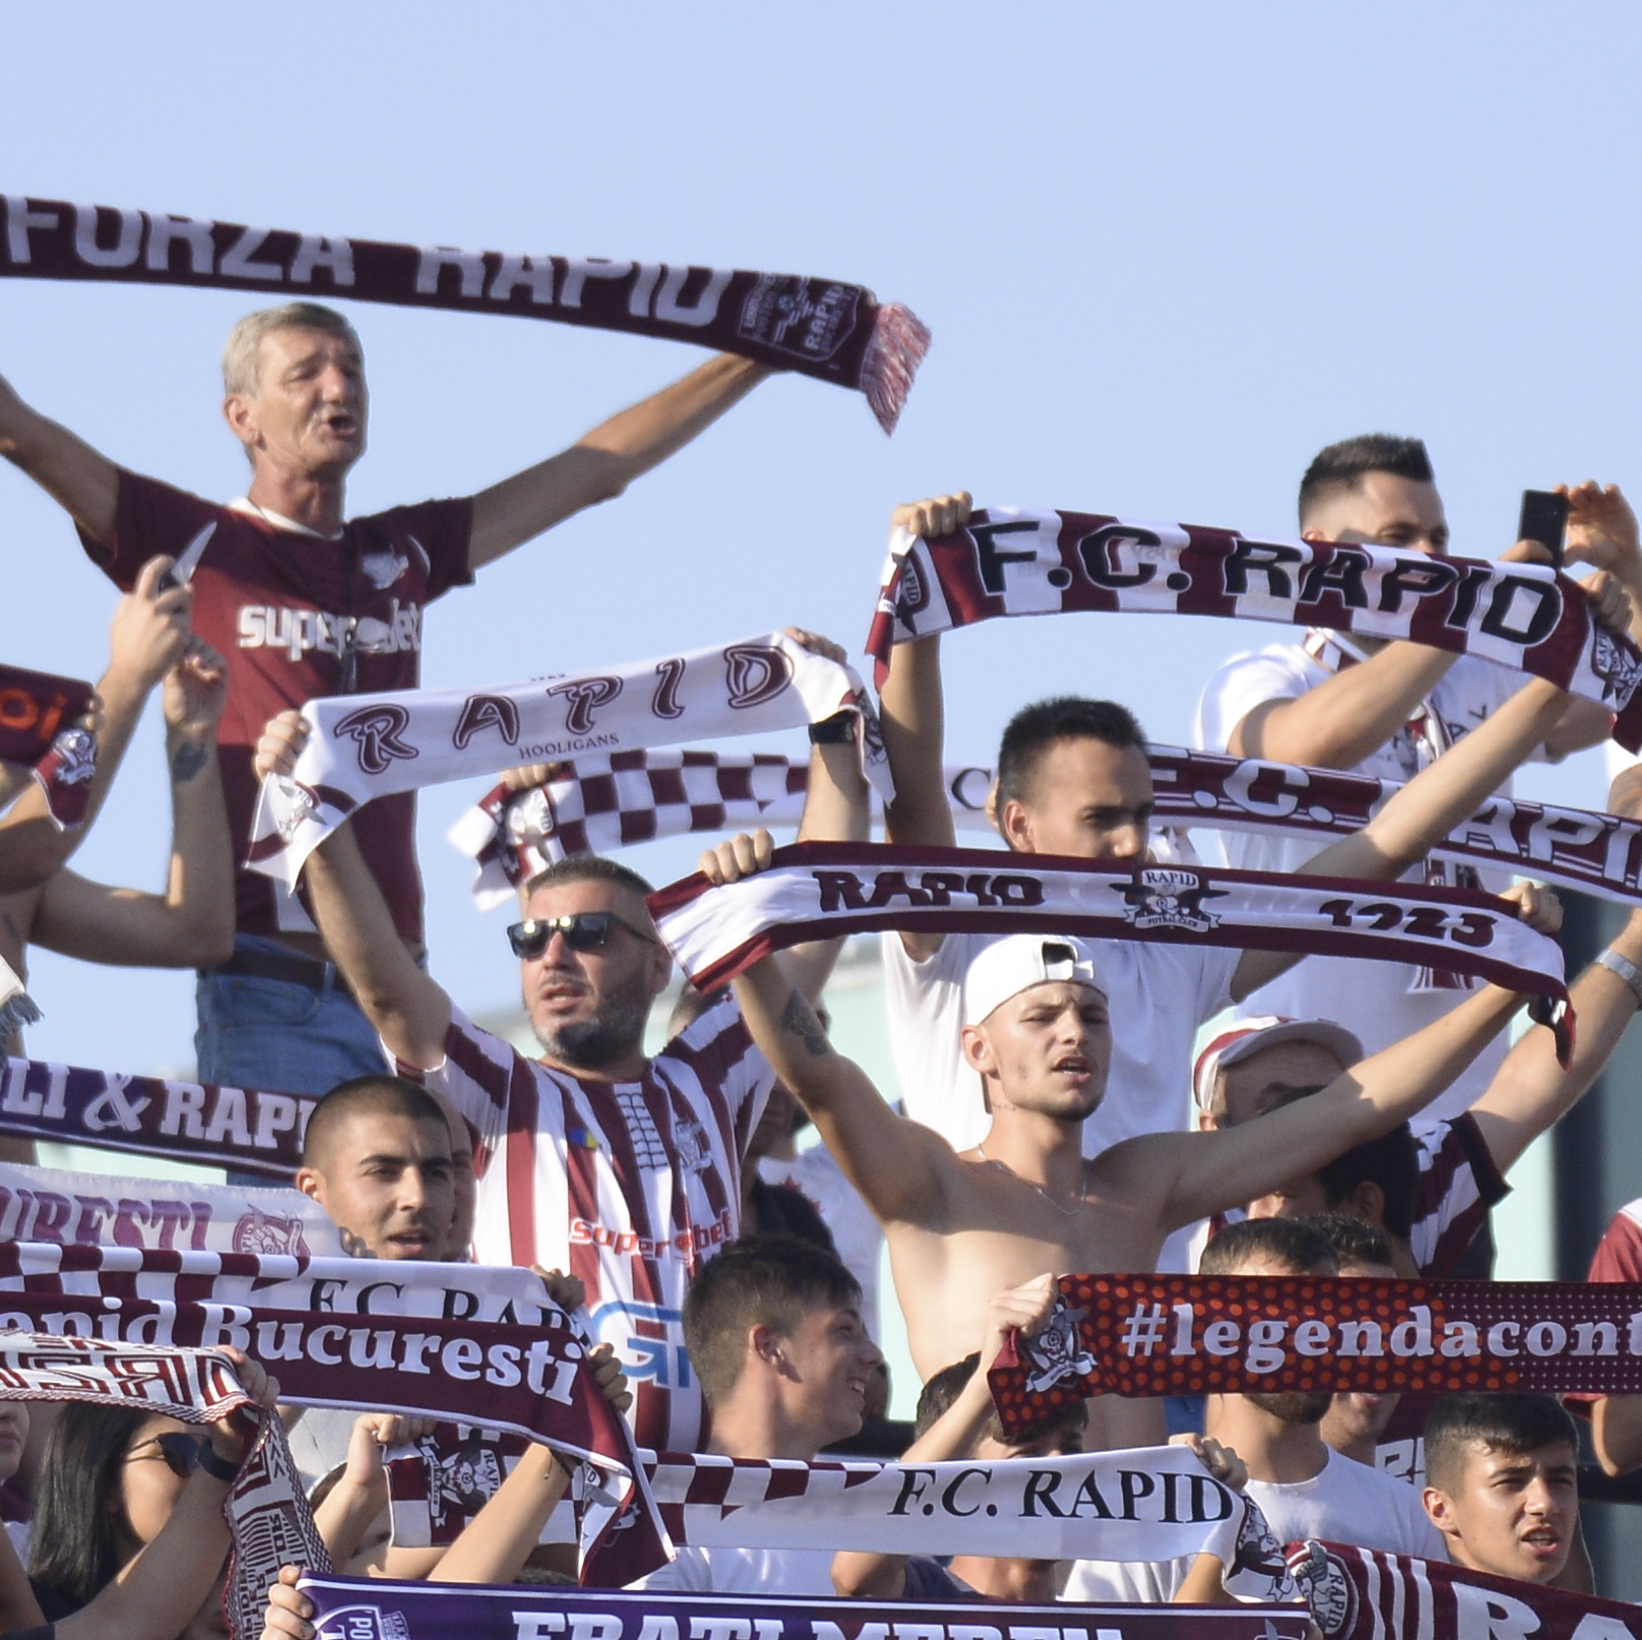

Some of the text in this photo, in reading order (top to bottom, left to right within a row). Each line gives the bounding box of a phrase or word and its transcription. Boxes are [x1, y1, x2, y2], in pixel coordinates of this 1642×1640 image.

[5, 195, 355, 286] FORZA
[416, 244, 727, 328] RAPID
[905, 565, 921, 603] APID
[968, 519, 1563, 647] F.C. RAPID
[334, 645, 795, 776] RAPID
[518, 731, 621, 760] HOOLIGANS
[812, 868, 1497, 947] RAPID 1923
[1145, 871, 1197, 887] RAPID
[85, 1072, 151, 1132] &
[162, 1082, 315, 1150] RAPI
[201, 1300, 584, 1406] Bucuresti
[483, 1450, 501, 1499] RAPI
[890, 1467, 1235, 1525] F.C. RAPID
[1328, 1572, 1346, 1630] RAPID
